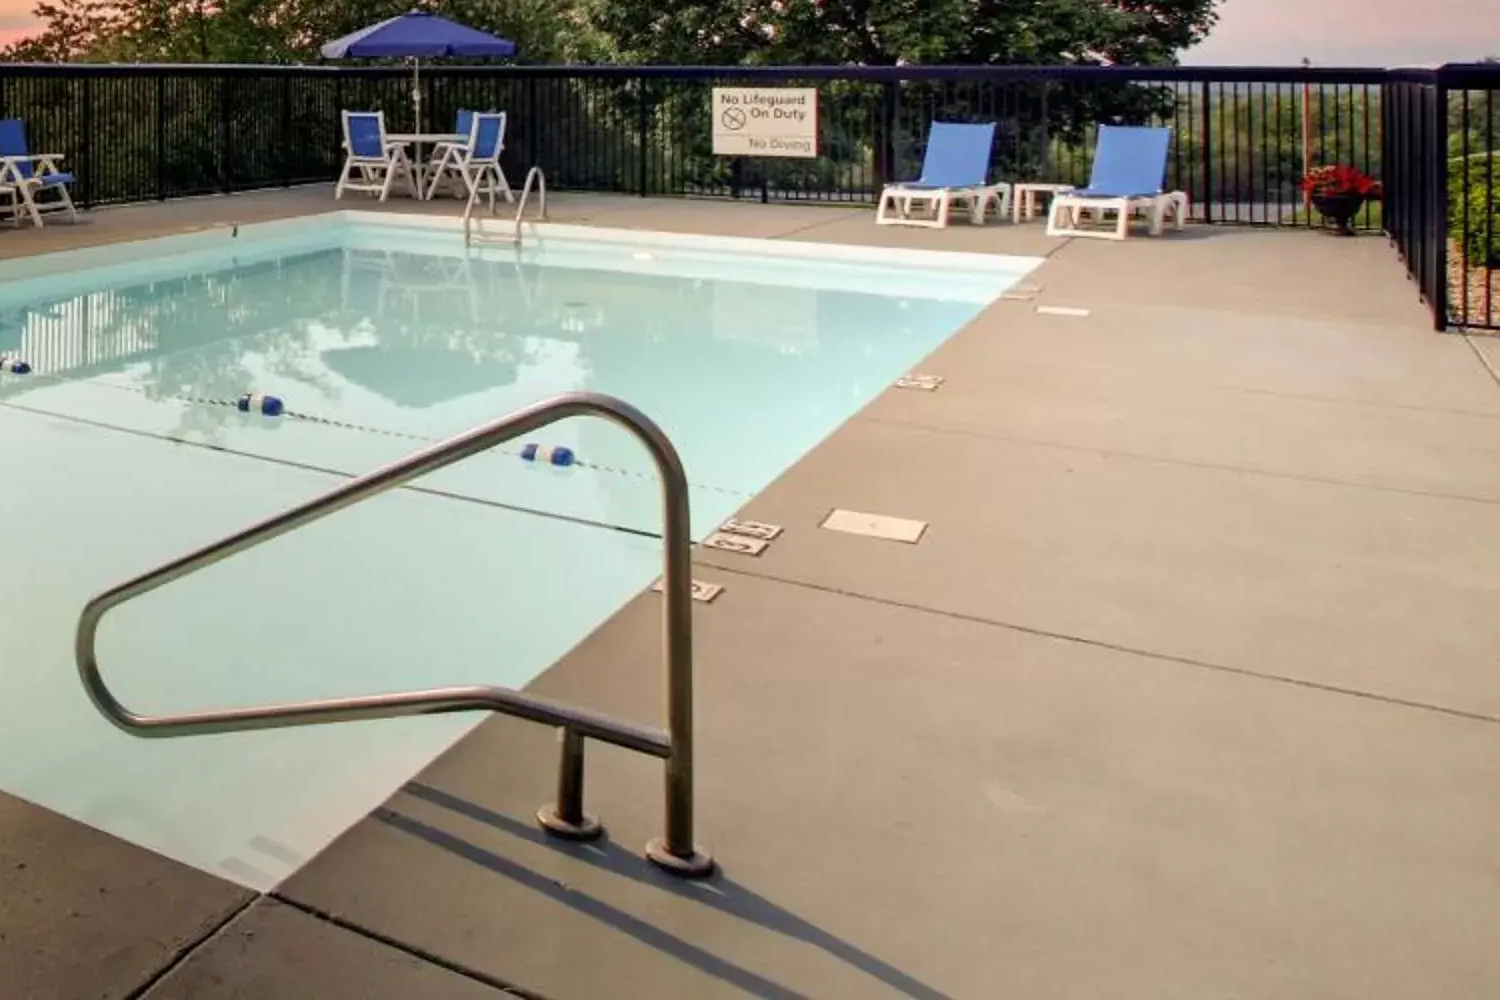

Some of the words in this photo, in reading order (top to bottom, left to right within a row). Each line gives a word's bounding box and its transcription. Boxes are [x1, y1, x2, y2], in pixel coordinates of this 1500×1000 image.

[721, 94, 739, 105] No
[743, 94, 805, 107] Lifeguard
[751, 107, 769, 119] On
[773, 107, 805, 122] Duty
